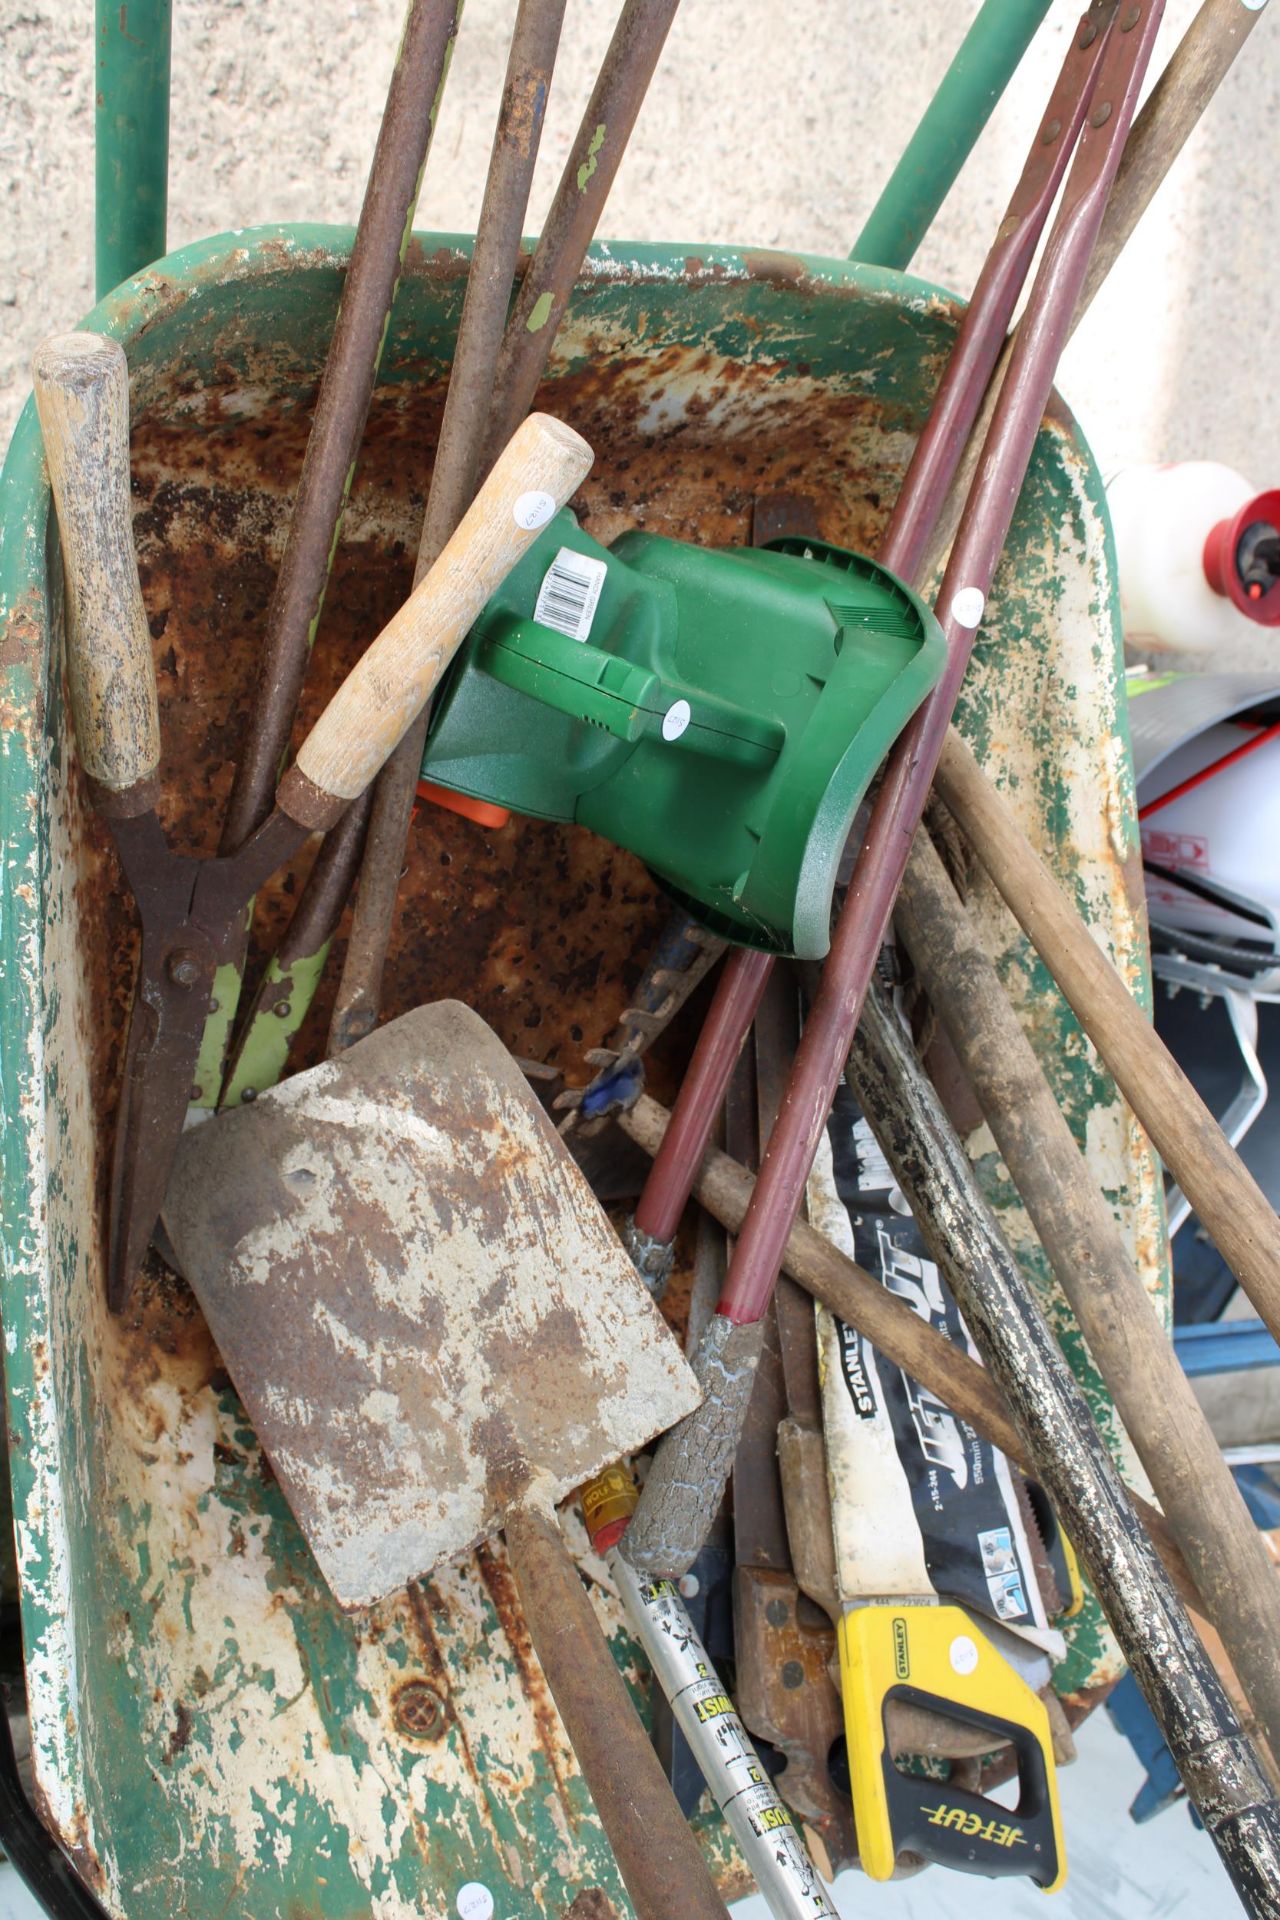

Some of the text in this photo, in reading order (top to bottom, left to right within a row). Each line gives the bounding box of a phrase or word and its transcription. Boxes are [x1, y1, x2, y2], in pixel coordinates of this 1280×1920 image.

[928, 1469, 944, 1512] 2-15-244
[896, 1623, 906, 1674] STANLEY
[924, 1804, 1026, 1848] JETCUT
